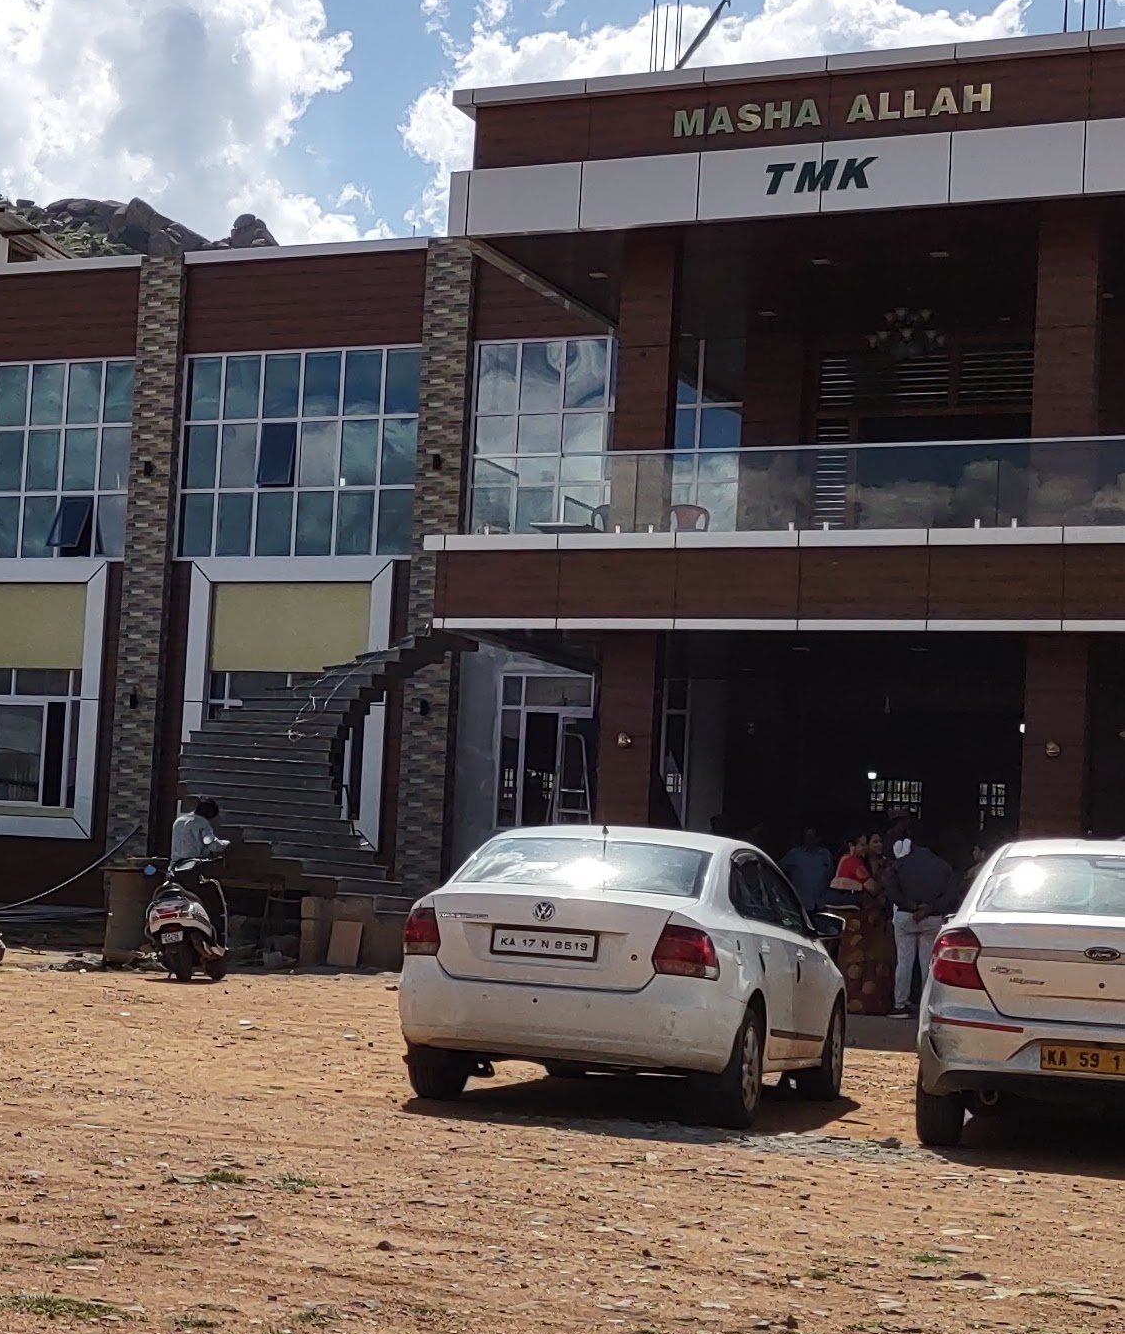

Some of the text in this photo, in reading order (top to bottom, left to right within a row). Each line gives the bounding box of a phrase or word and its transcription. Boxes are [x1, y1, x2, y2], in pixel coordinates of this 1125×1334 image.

[673, 83, 992, 138] MASHA ALLAH
[765, 156, 879, 195] TMK
[500, 937, 516, 947] KA
[522, 938, 536, 948] 17
[541, 940, 550, 949] N
[1047, 1049, 1125, 1071] KA 59 1
